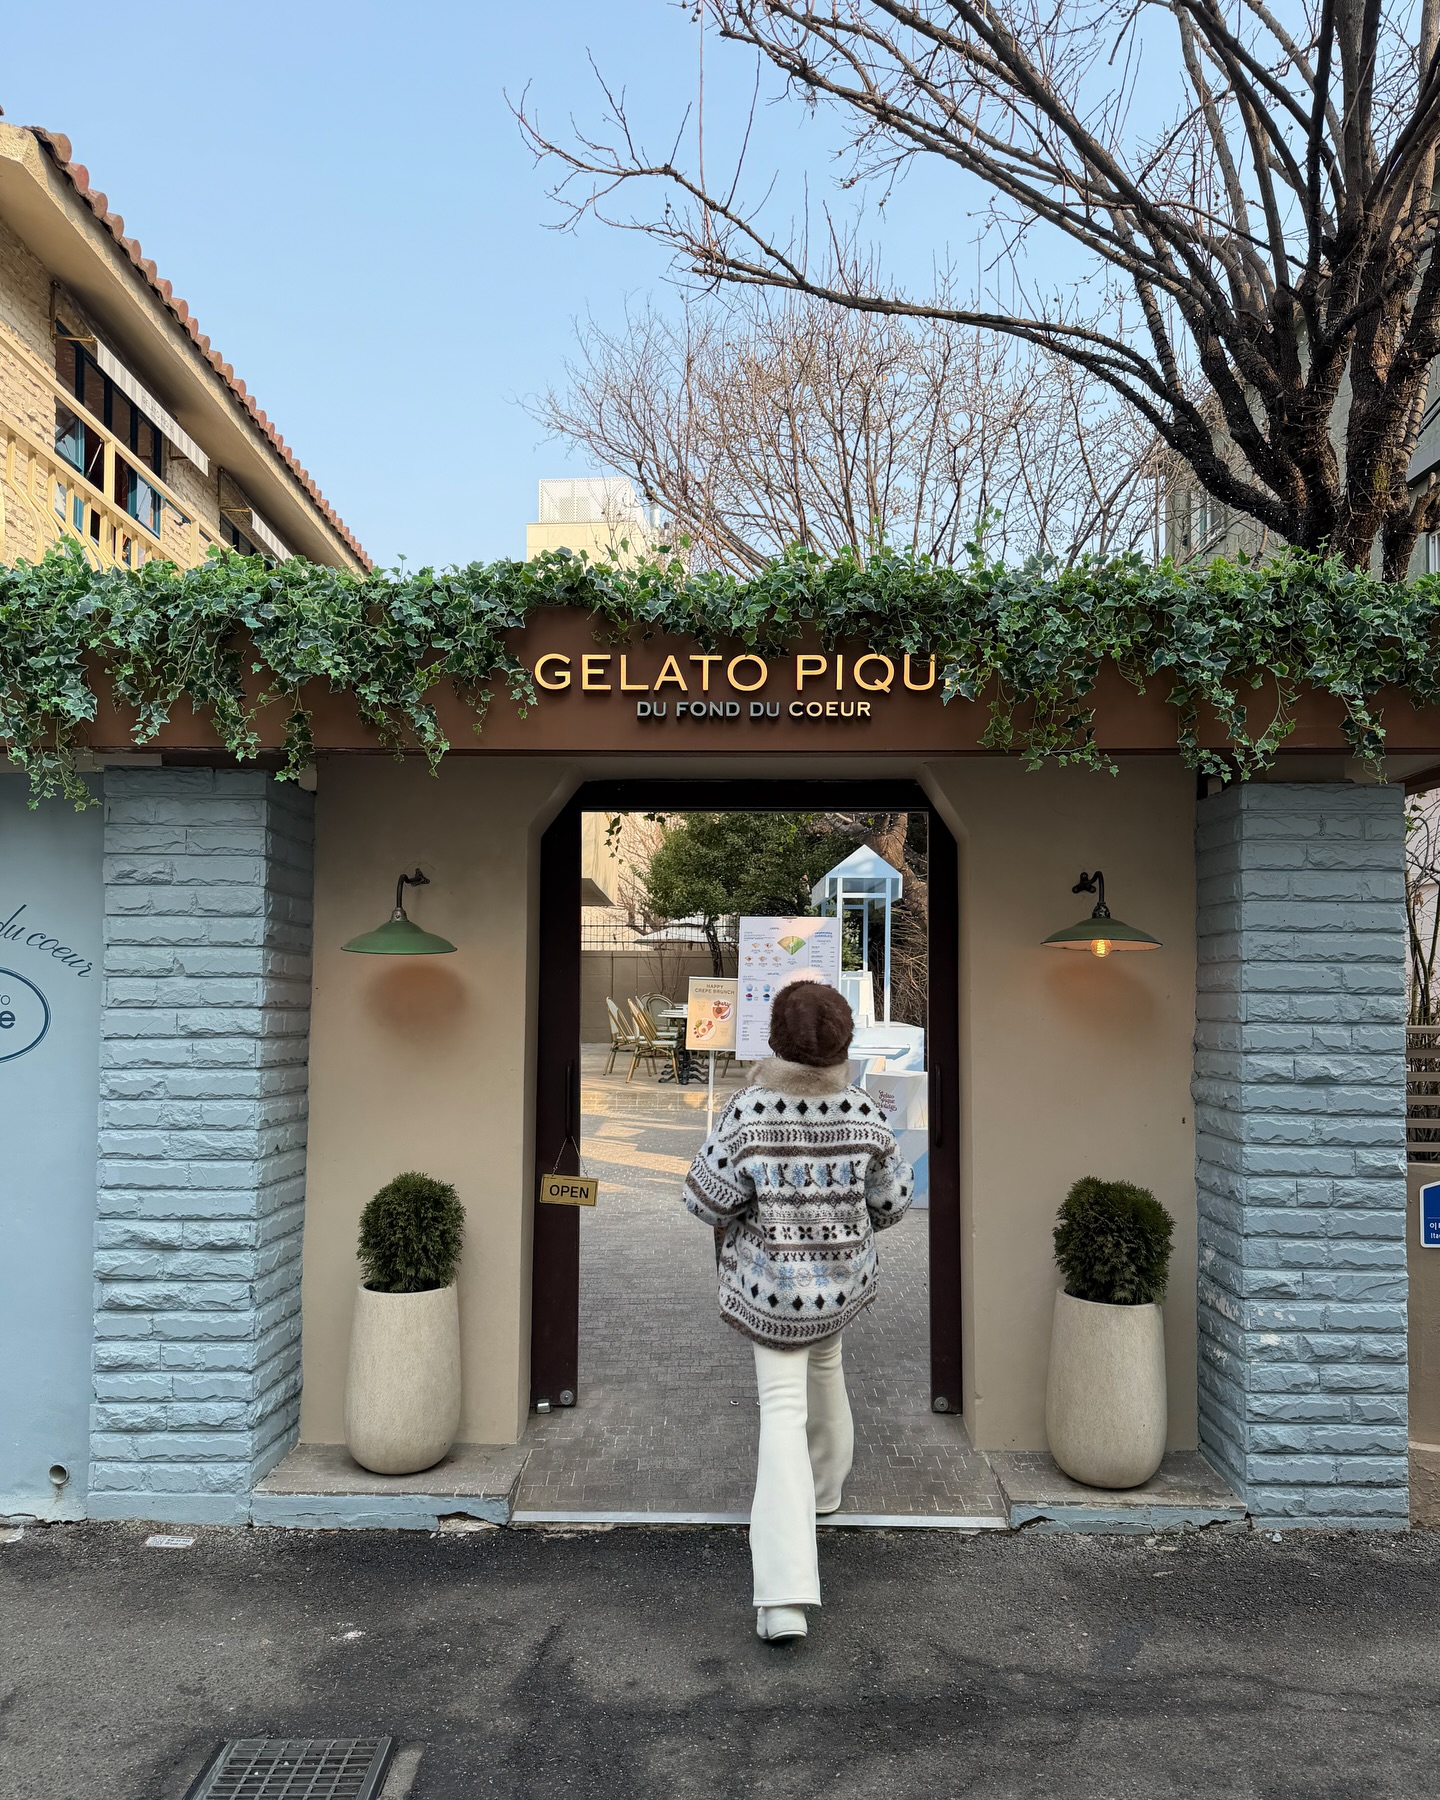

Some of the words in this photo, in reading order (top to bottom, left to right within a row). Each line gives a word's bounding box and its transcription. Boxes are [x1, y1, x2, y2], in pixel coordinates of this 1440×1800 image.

[533, 653, 769, 693] GELATO
[795, 653, 960, 694] PIQU
[636, 701, 668, 718] DU
[676, 701, 741, 718] FOND
[749, 701, 781, 718] DU
[788, 701, 872, 718] COEUR
[0, 904, 27, 940] du
[26, 932, 93, 978] coeur
[549, 1184, 590, 1199] OPEN
